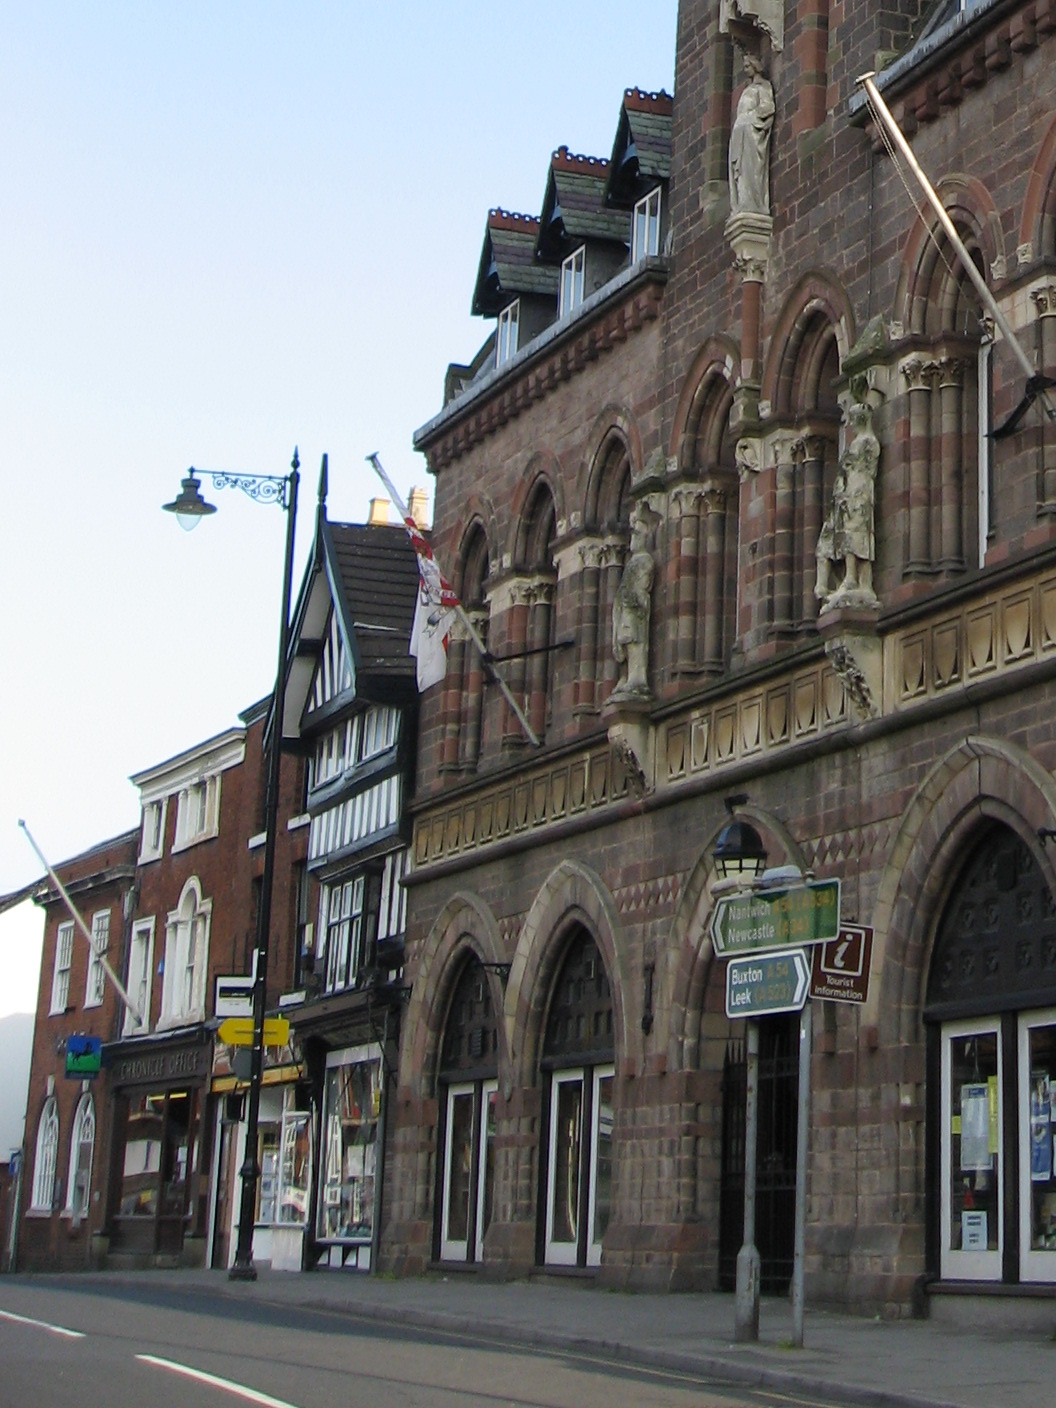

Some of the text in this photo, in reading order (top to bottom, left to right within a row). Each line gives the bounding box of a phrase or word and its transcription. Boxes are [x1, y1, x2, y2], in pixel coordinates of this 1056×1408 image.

[728, 901, 771, 921] Nantwich
[728, 923, 775, 943] Newcastle
[732, 967, 763, 985] Buxton
[826, 974, 854, 988] Tourist
[731, 988, 752, 1007] Leek
[169, 1050, 199, 1074] OFFICE
